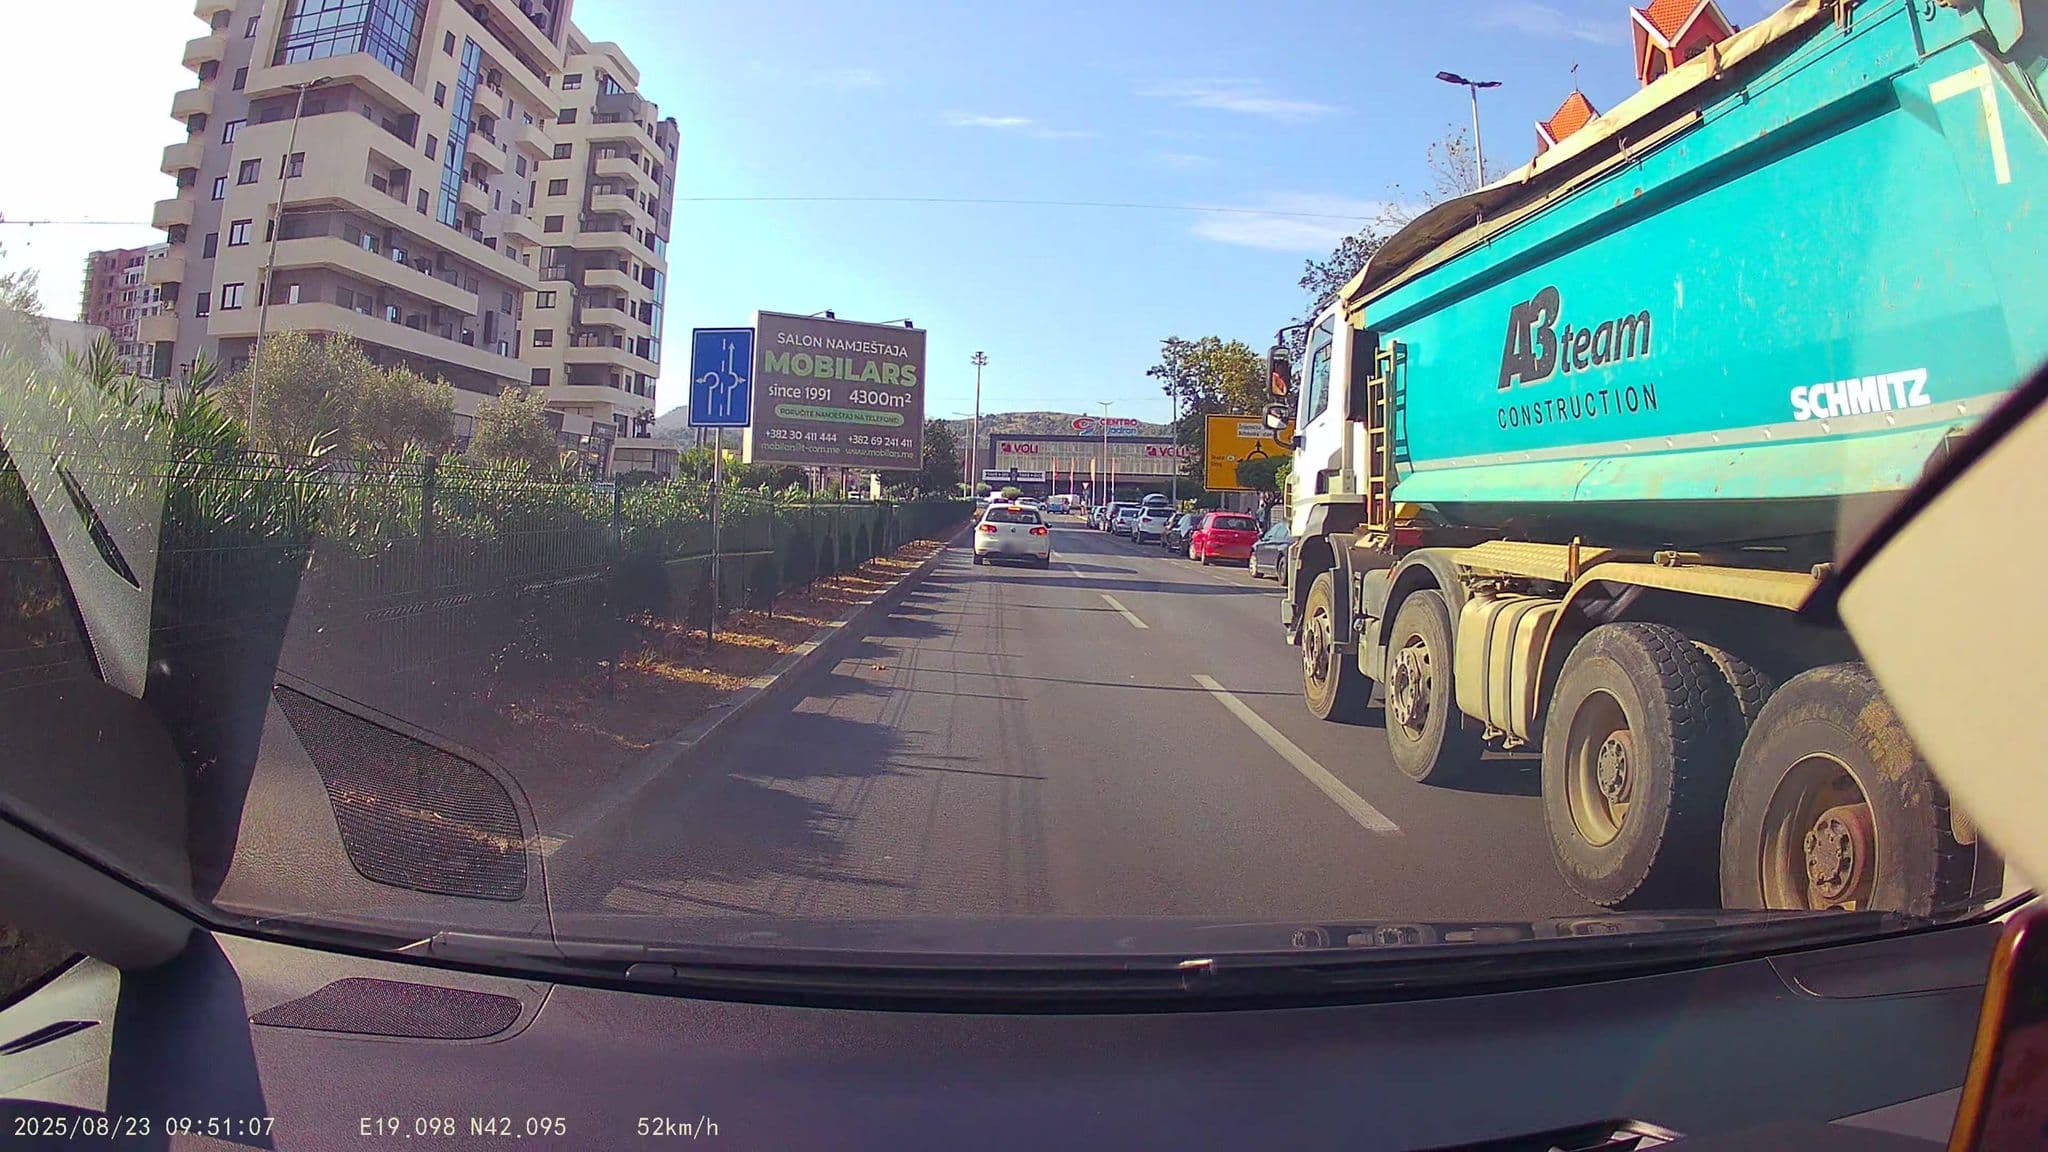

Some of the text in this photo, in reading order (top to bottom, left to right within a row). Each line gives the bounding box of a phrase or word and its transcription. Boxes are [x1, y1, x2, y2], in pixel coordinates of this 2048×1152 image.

[777, 332, 908, 358] SALON NAMJEŠTAJA
[765, 350, 917, 387] MOBILARS
[769, 383, 831, 401] since 1991
[1790, 367, 1931, 421] SCHMITZ
[1498, 383, 1657, 429] CONSTRUCTION
[1099, 418, 1138, 426] CENTRO
[766, 428, 837, 443] +382 30 411 444
[847, 434, 913, 449] +382 69 241 411
[1014, 443, 1039, 454] VOLI
[1159, 446, 1185, 458] VOLI
